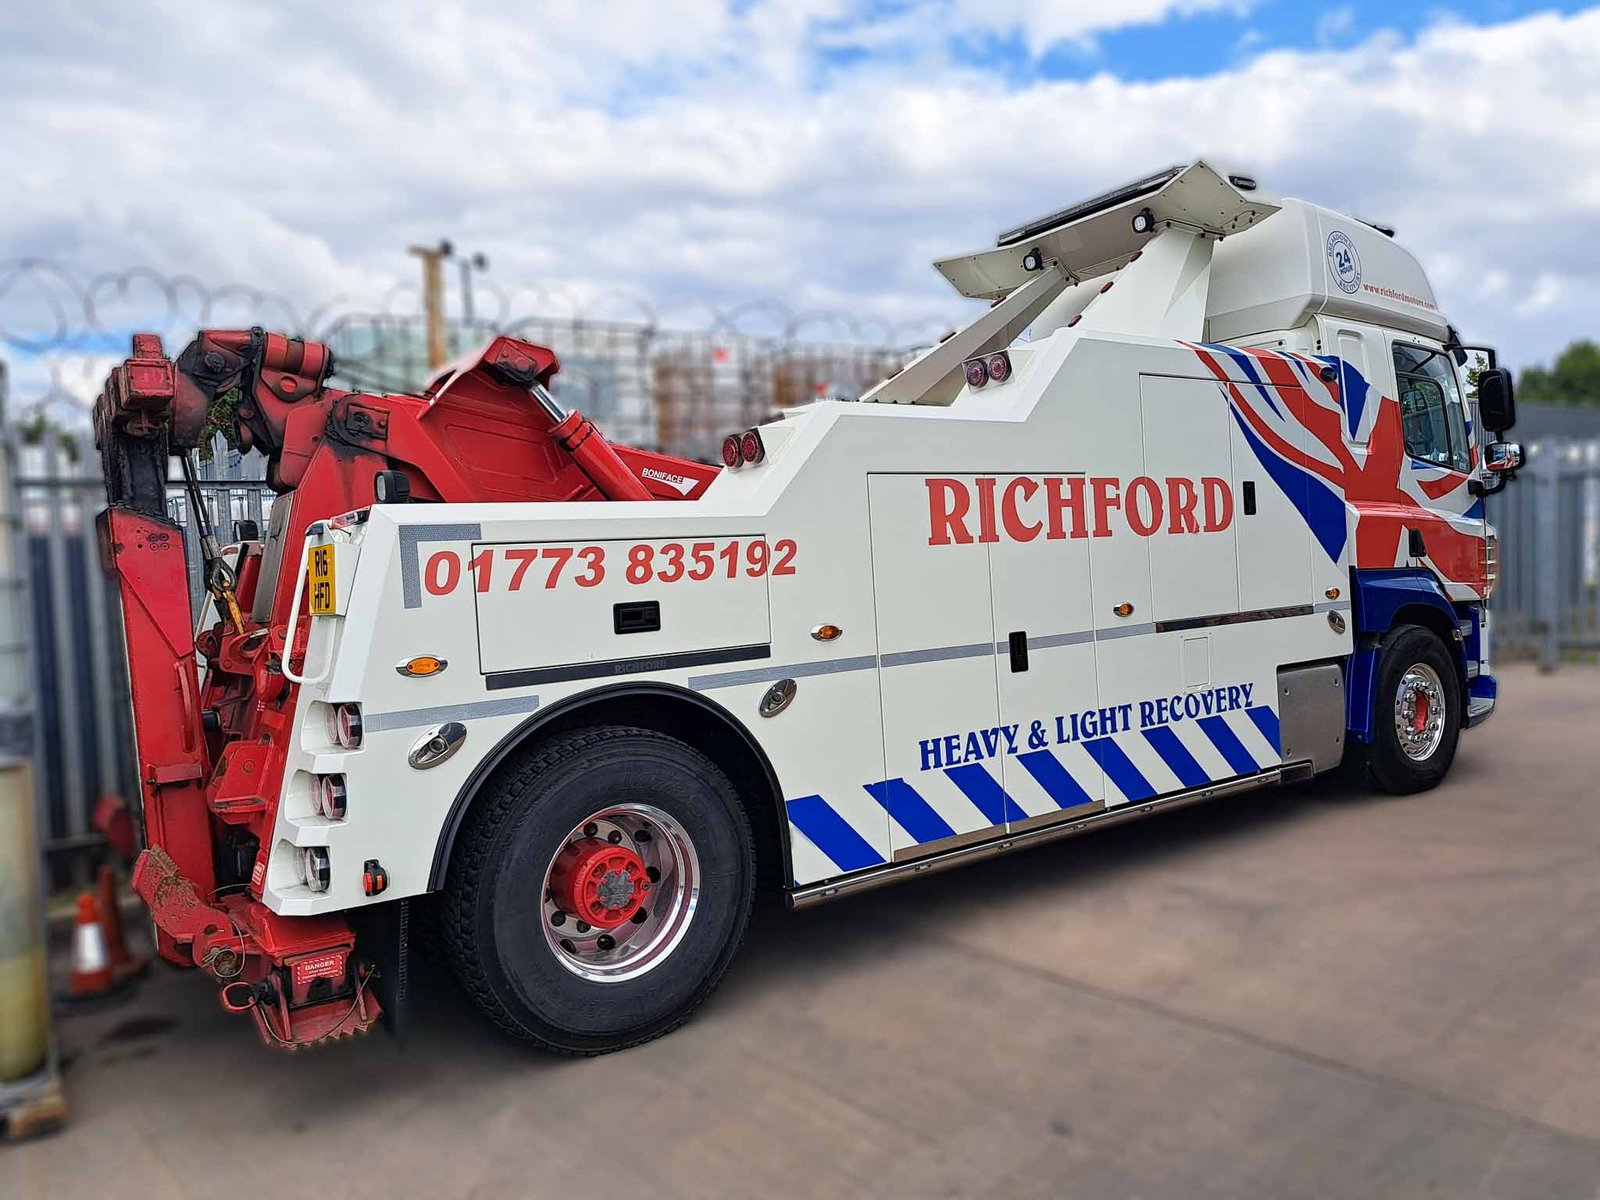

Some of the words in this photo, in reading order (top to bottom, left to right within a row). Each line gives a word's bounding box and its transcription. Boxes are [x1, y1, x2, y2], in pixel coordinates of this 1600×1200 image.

[1336, 249, 1351, 268] 24
[1340, 265, 1353, 275] HOUR
[1339, 272, 1361, 291] RECOVERY
[642, 467, 684, 484] BONIFACE
[925, 476, 1234, 545] RICHFORD
[314, 549, 328, 577] R16
[424, 546, 606, 596] 01773
[625, 539, 797, 585] 835192
[314, 582, 331, 609] HFD
[614, 660, 666, 674] RICHFORD
[919, 724, 1020, 771] HEAVY
[1027, 720, 1049, 750] &
[1055, 703, 1133, 745] LIGHT
[1140, 682, 1254, 728] RECOVERY
[305, 960, 335, 971] DANGER
